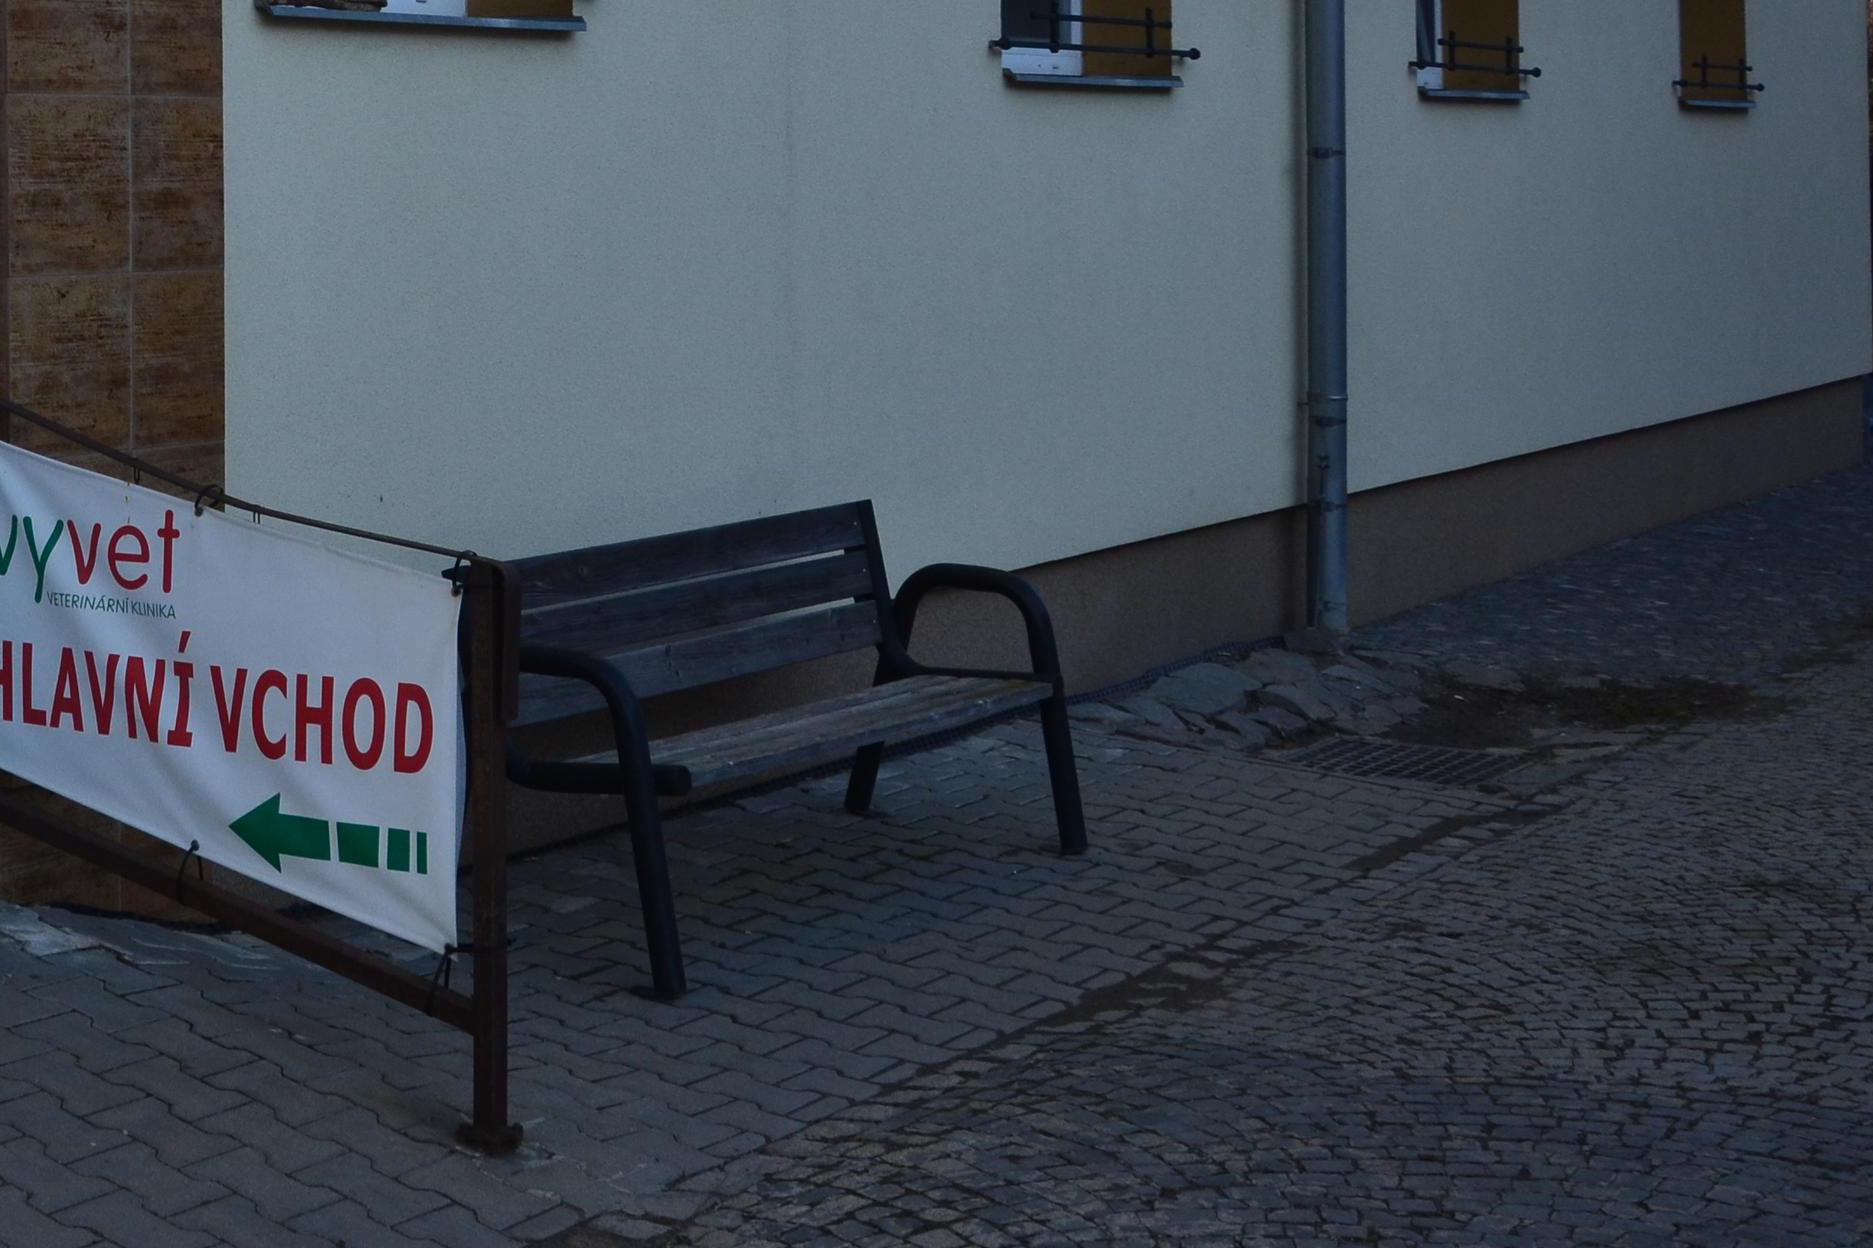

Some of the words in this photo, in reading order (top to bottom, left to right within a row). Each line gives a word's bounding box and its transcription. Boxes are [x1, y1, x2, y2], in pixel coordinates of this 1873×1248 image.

[47, 591, 129, 614] VETERINÁRNÍ
[131, 601, 177, 620] KLINIKA
[209, 664, 435, 775] VCHOD
